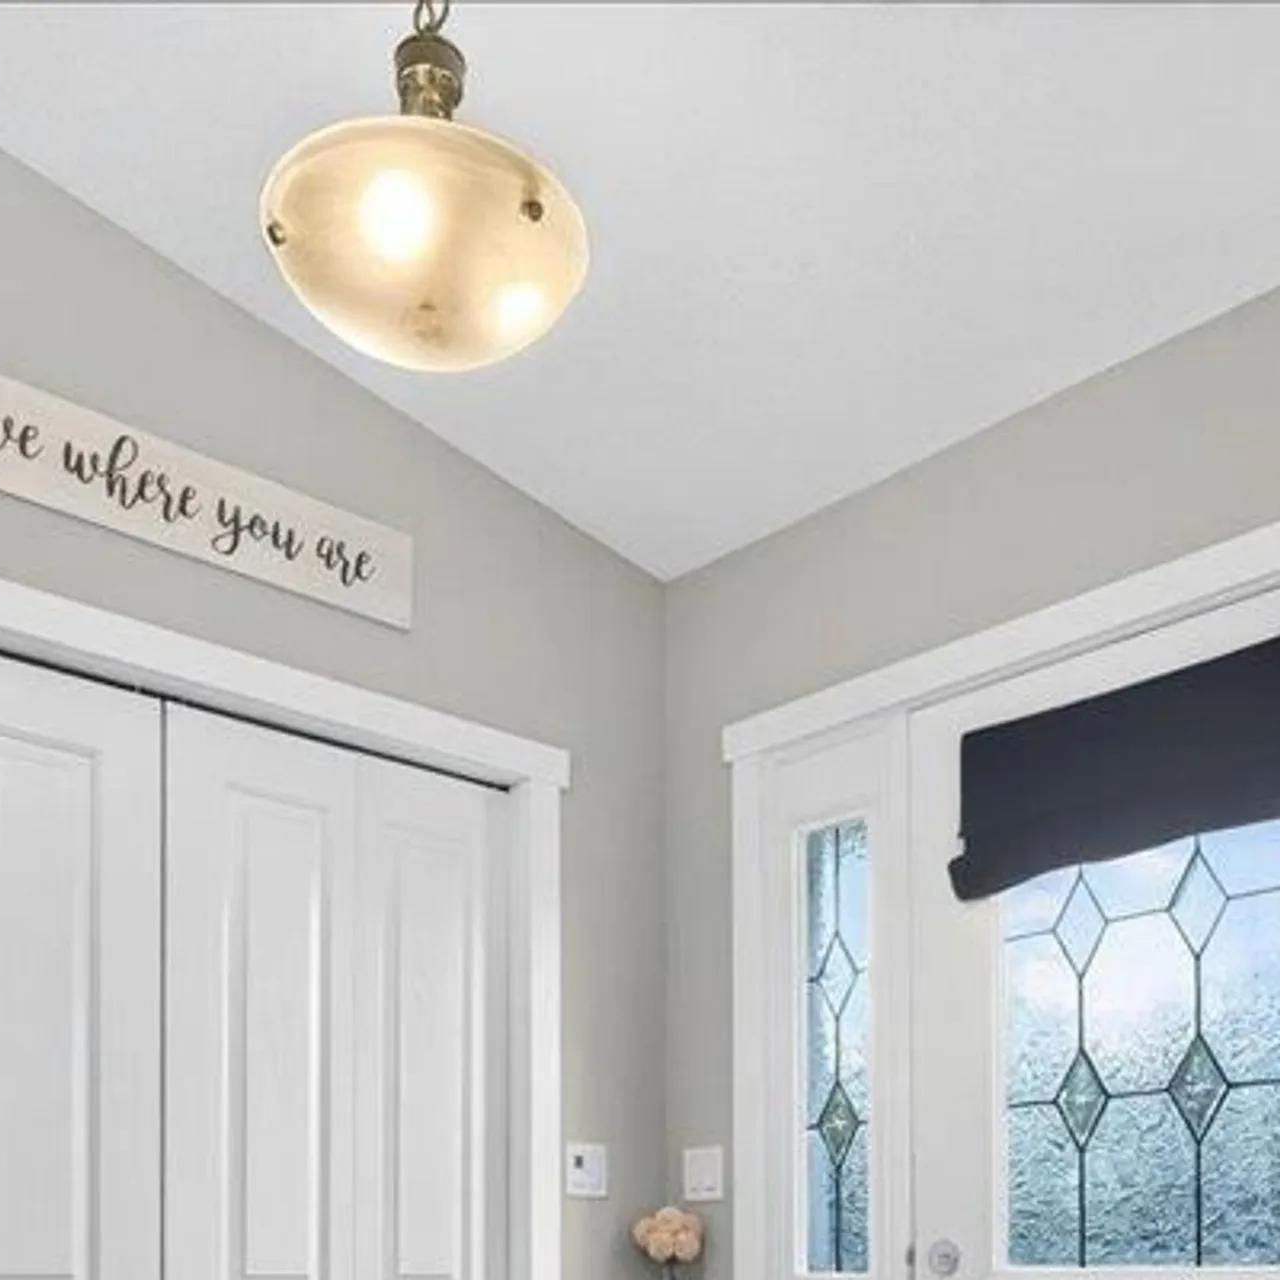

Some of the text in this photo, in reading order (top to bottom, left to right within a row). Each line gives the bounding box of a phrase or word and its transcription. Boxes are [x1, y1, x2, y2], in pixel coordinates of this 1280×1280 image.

[63, 434, 200, 522] where
[211, 497, 304, 559] you
[316, 534, 376, 586] are
